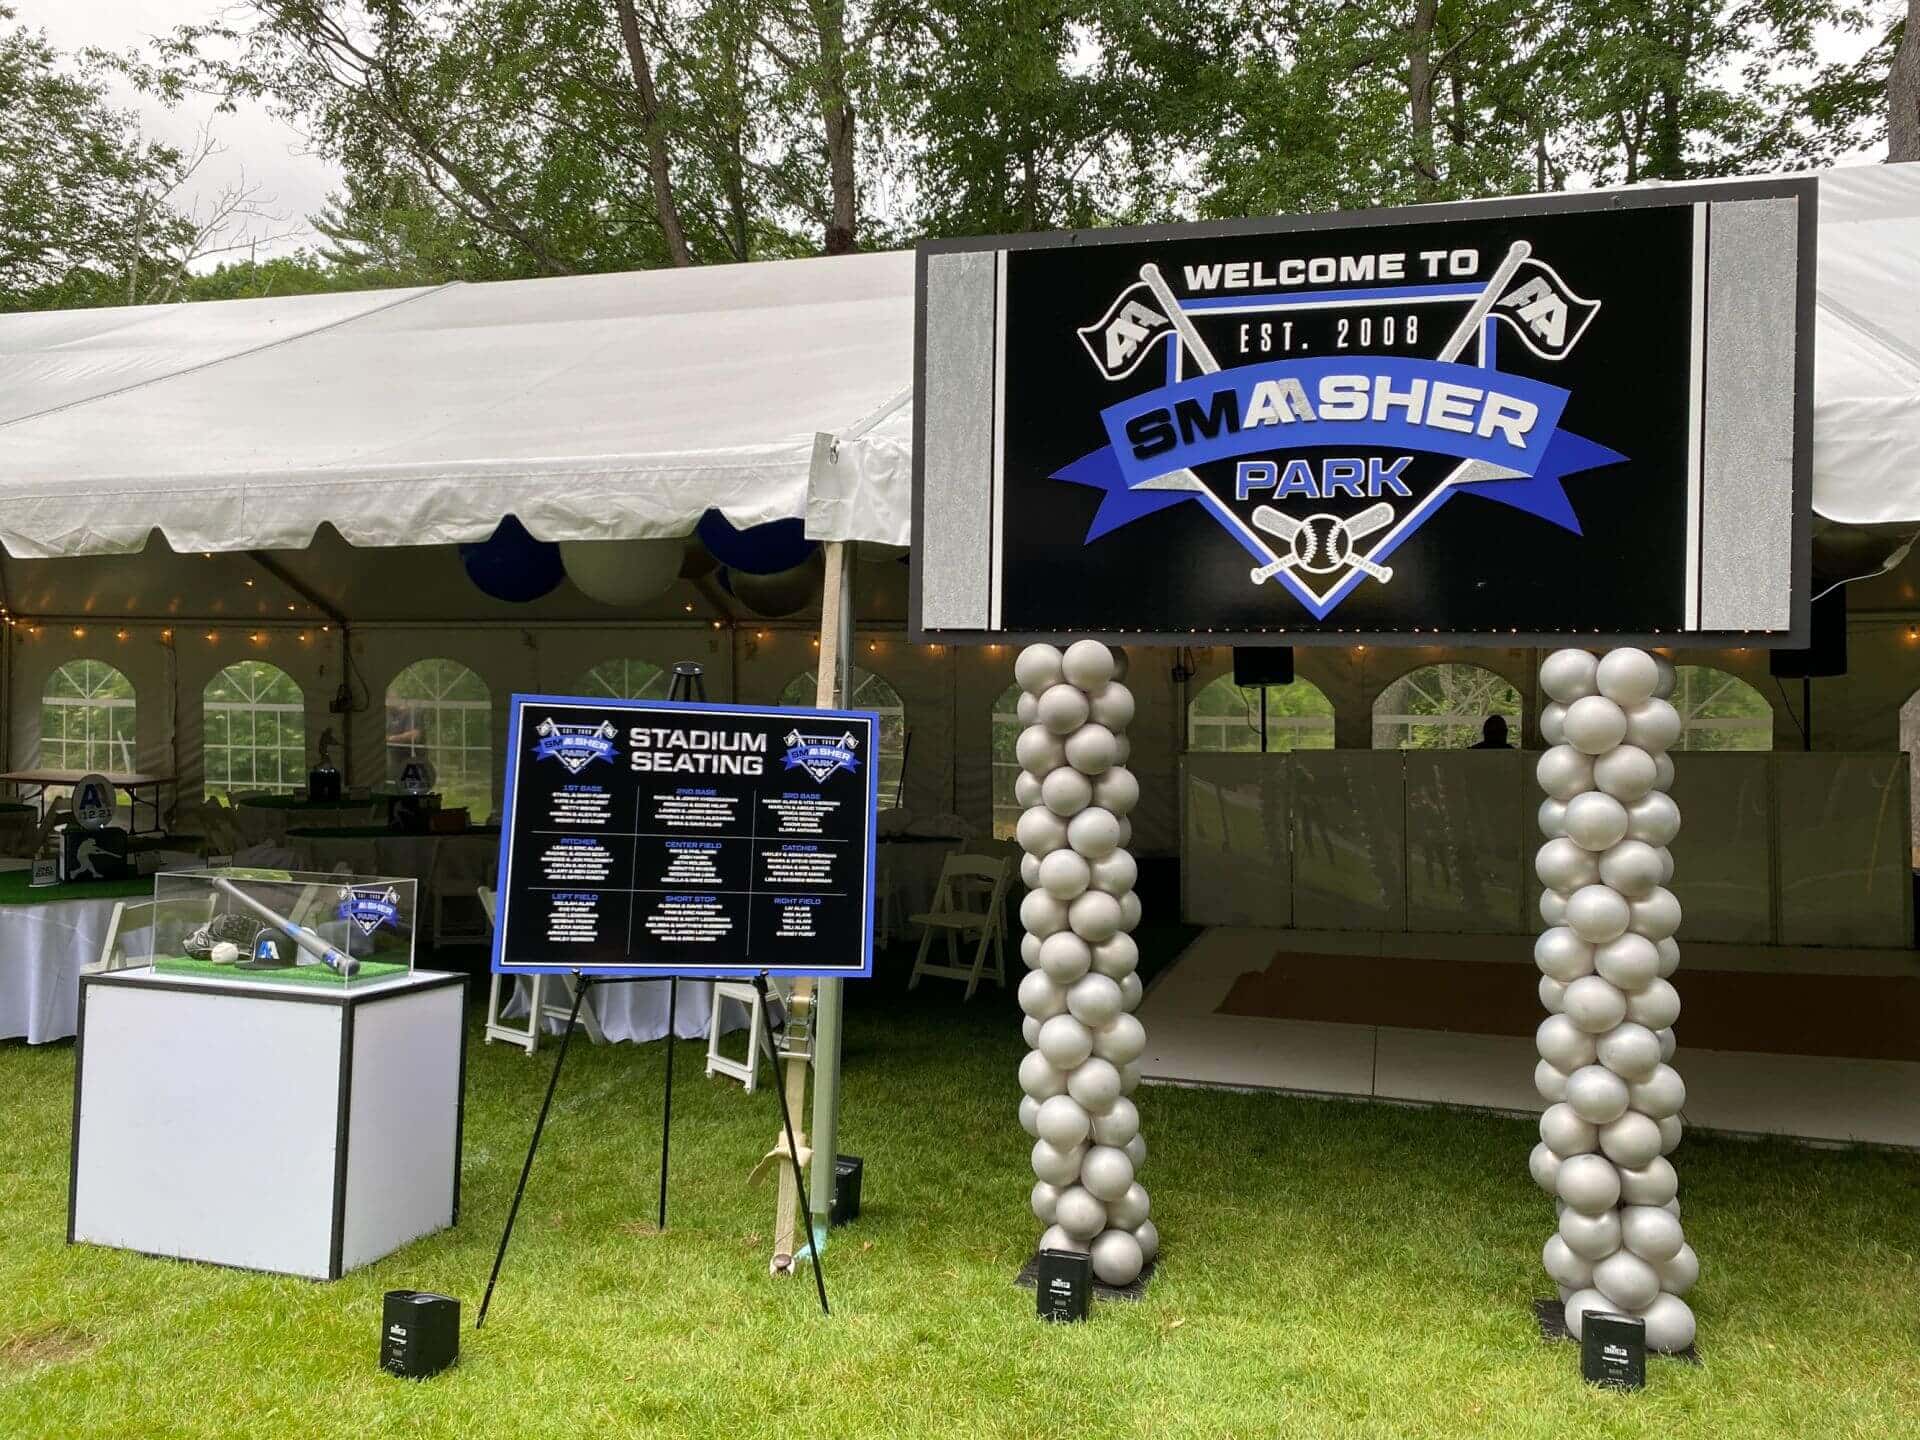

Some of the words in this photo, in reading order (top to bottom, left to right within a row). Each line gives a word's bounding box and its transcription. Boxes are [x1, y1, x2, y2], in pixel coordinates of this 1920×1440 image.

[1183, 253, 1406, 291] WELCOME
[1420, 249, 1480, 278] TO
[1240, 322, 1309, 353] EST.
[1337, 315, 1419, 349] 2008
[1235, 456, 1414, 501] PARK
[629, 727, 767, 753] STADIUM
[631, 751, 763, 776] SEATING
[807, 759, 835, 768] PARK
[560, 838, 597, 846] PITCHER
[665, 841, 698, 849] CENTER
[781, 844, 818, 852] CATCHER
[551, 893, 573, 901] LEFT
[773, 897, 798, 905] RIGHT
